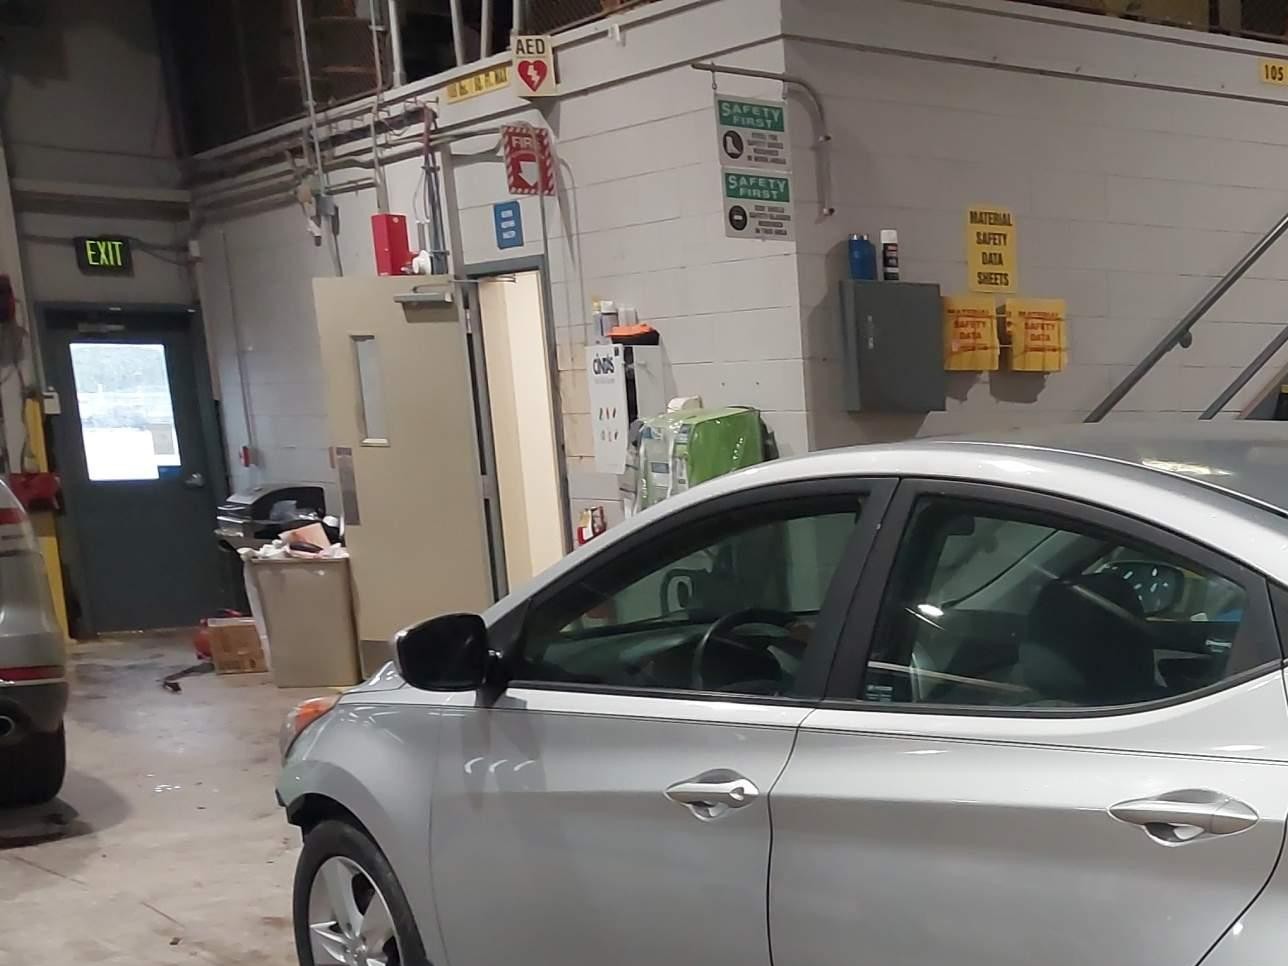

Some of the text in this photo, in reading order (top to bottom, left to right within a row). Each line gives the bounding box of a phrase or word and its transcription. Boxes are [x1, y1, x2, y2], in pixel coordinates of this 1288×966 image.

[515, 39, 545, 55] AED
[1264, 64, 1284, 82] 105
[721, 102, 780, 122] SAFETY
[733, 115, 772, 128] FIRST
[511, 136, 541, 149] FIR
[728, 175, 786, 193] SAFETY
[740, 187, 778, 200] FIRST
[969, 210, 1012, 226] MATERIAL
[976, 231, 1007, 246] SAFETY
[85, 240, 124, 266] EXIT
[982, 251, 1003, 266] DATA
[977, 271, 1009, 286] SHEETS
